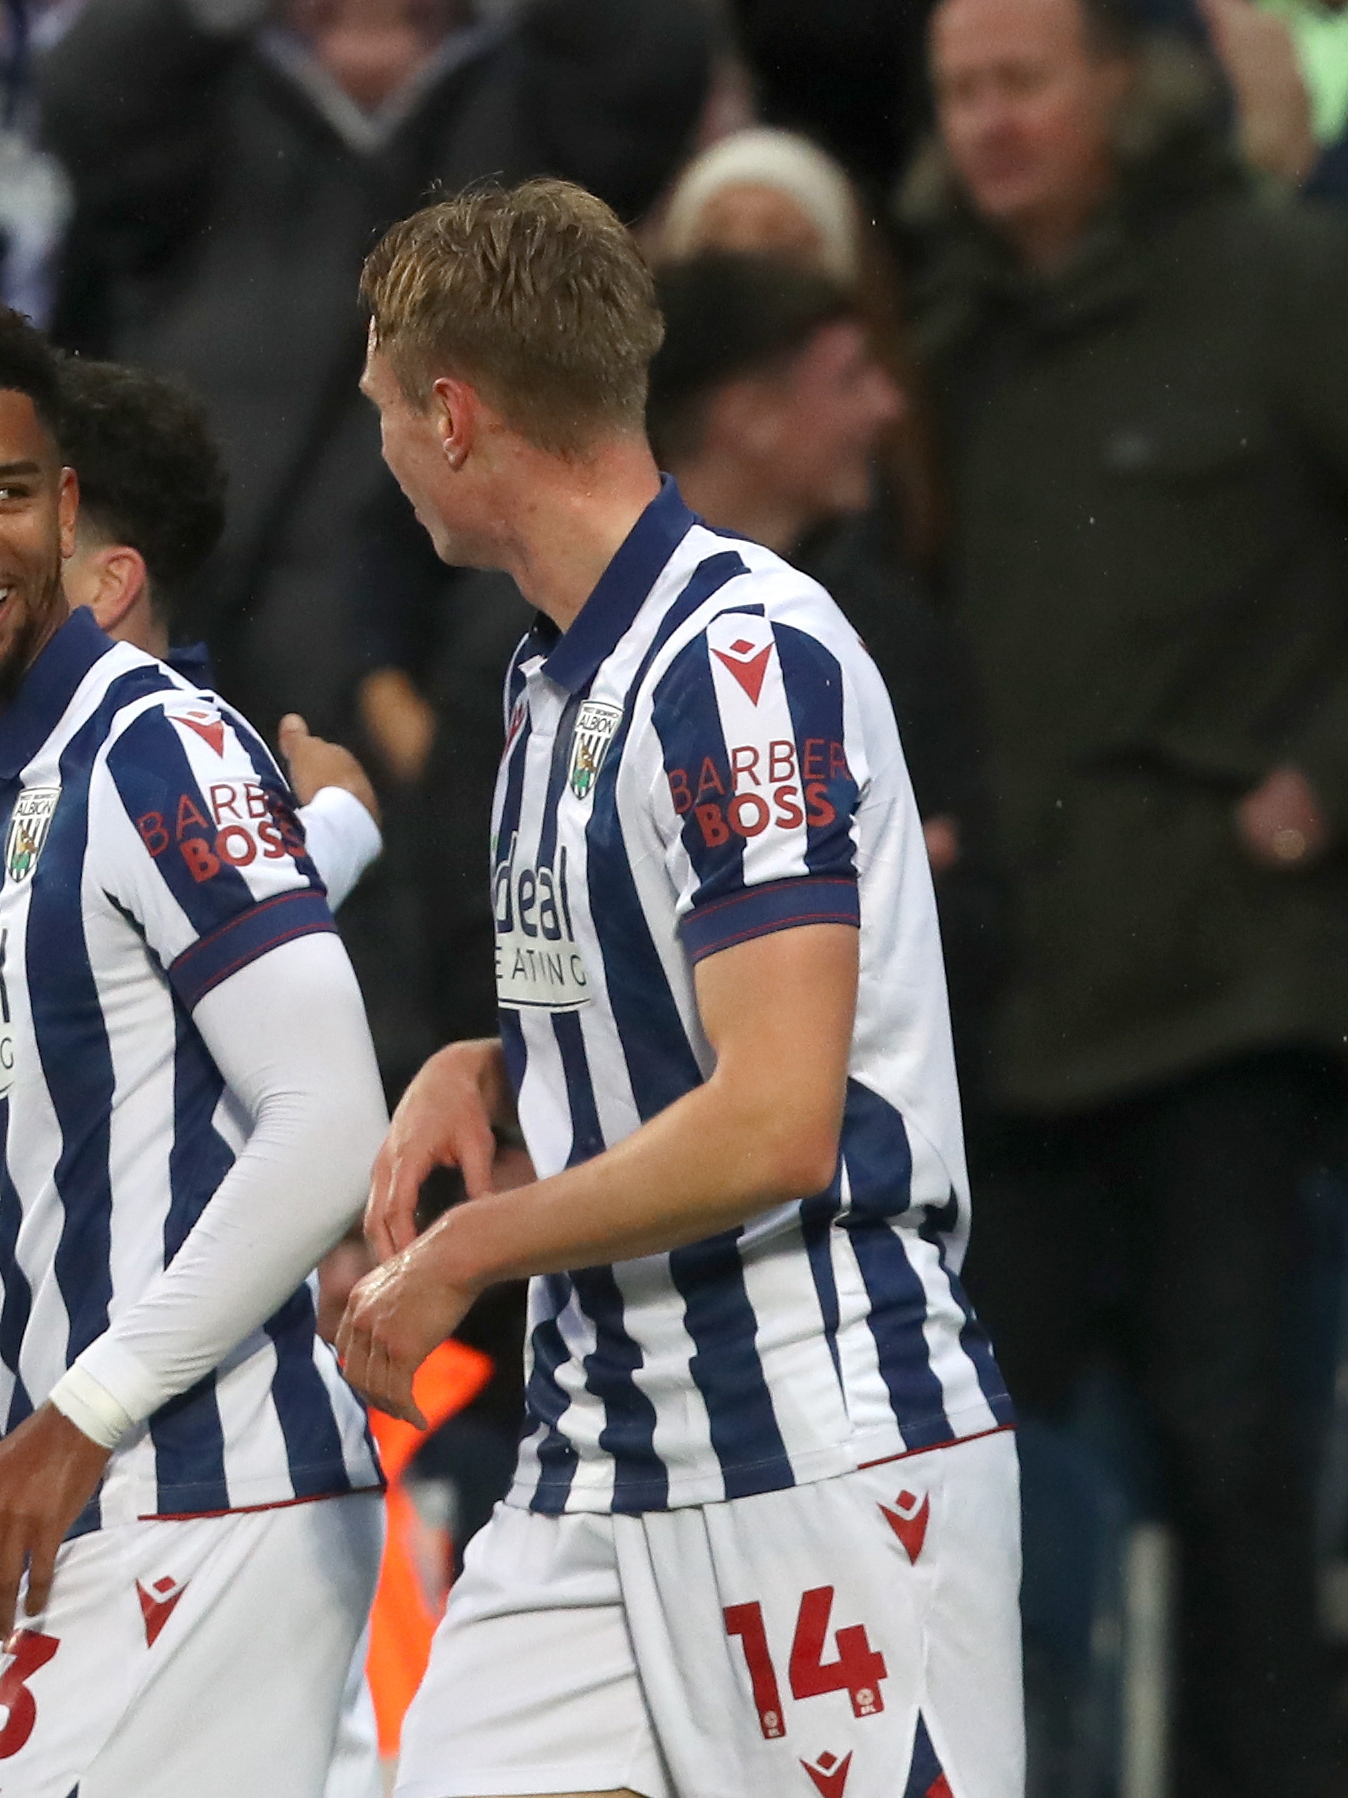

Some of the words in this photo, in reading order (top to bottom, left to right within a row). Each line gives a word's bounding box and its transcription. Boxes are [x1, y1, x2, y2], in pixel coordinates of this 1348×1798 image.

[576, 714, 616, 733] ALBION
[668, 738, 853, 815] BARBER
[137, 783, 292, 858] BARB
[180, 821, 306, 883] BOSS
[694, 782, 836, 848] BOSS
[494, 836, 575, 942] deal
[723, 1585, 888, 1739] 14
